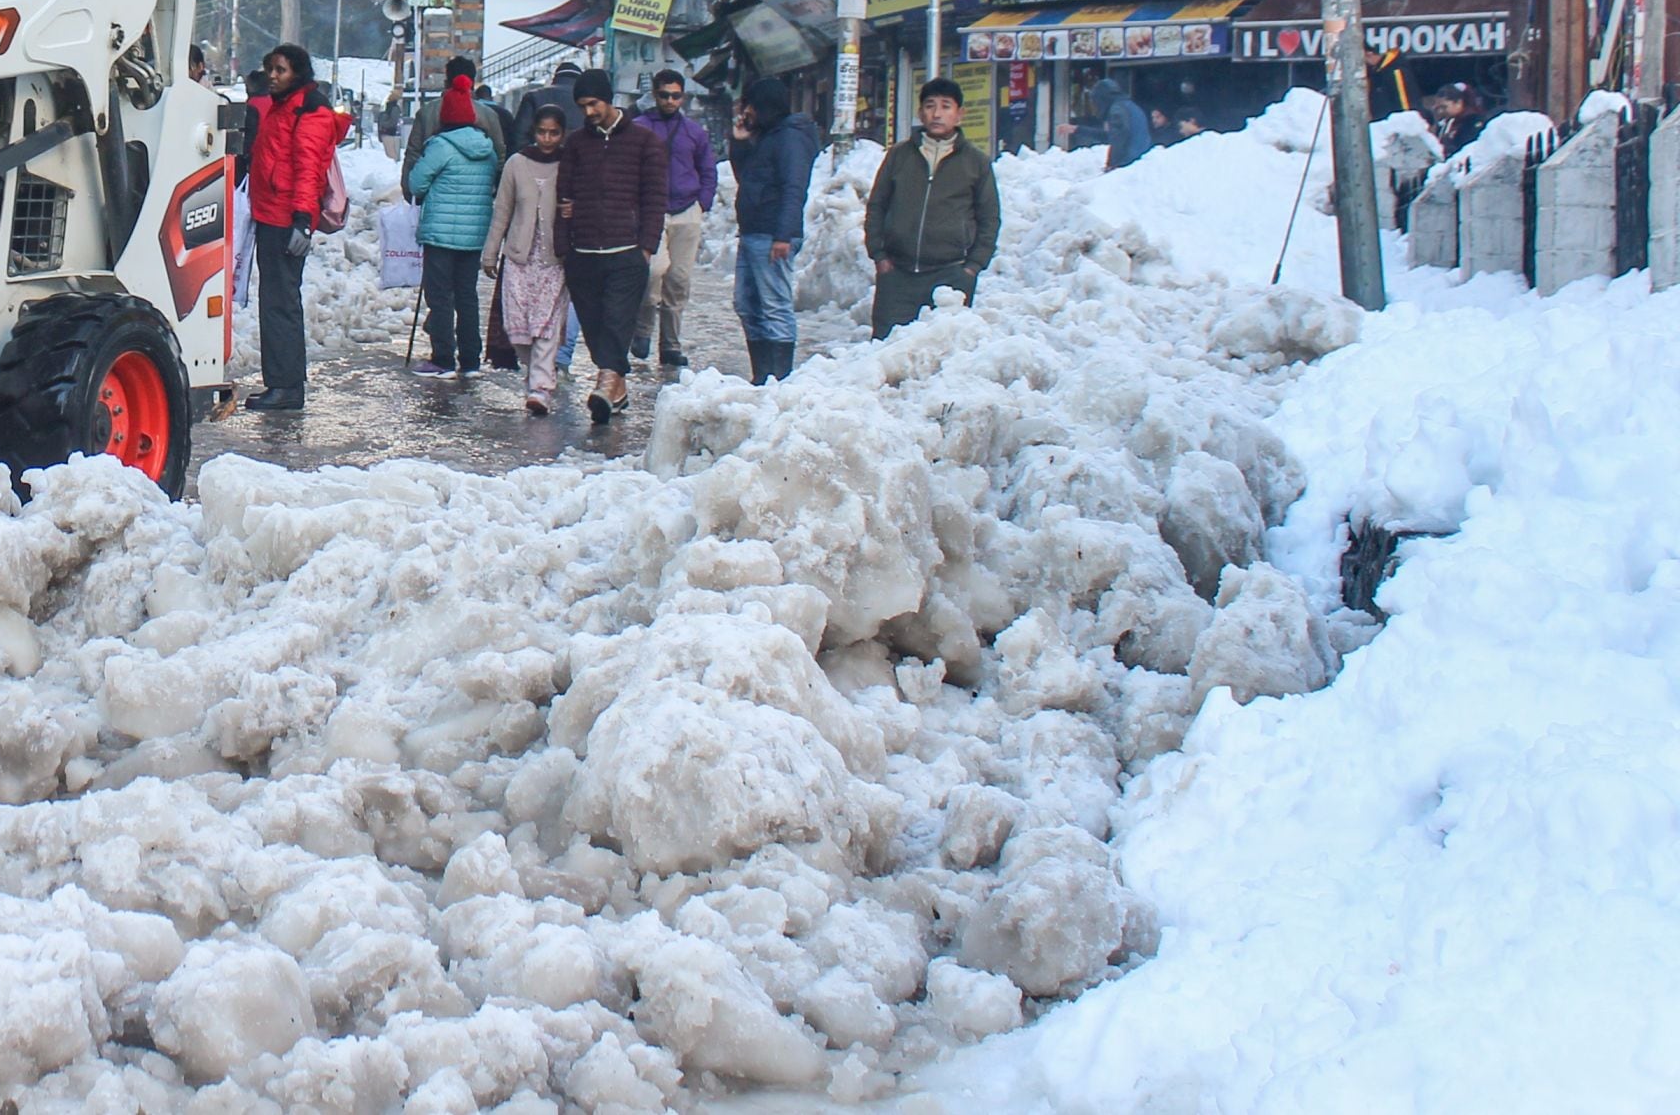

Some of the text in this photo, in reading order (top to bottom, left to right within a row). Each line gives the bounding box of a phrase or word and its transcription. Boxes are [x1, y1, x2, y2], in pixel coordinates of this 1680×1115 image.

[617, 4, 665, 24] DHABA
[1243, 31, 1252, 57] I
[1366, 22, 1506, 54] HOOKAH
[185, 203, 218, 231] S590
